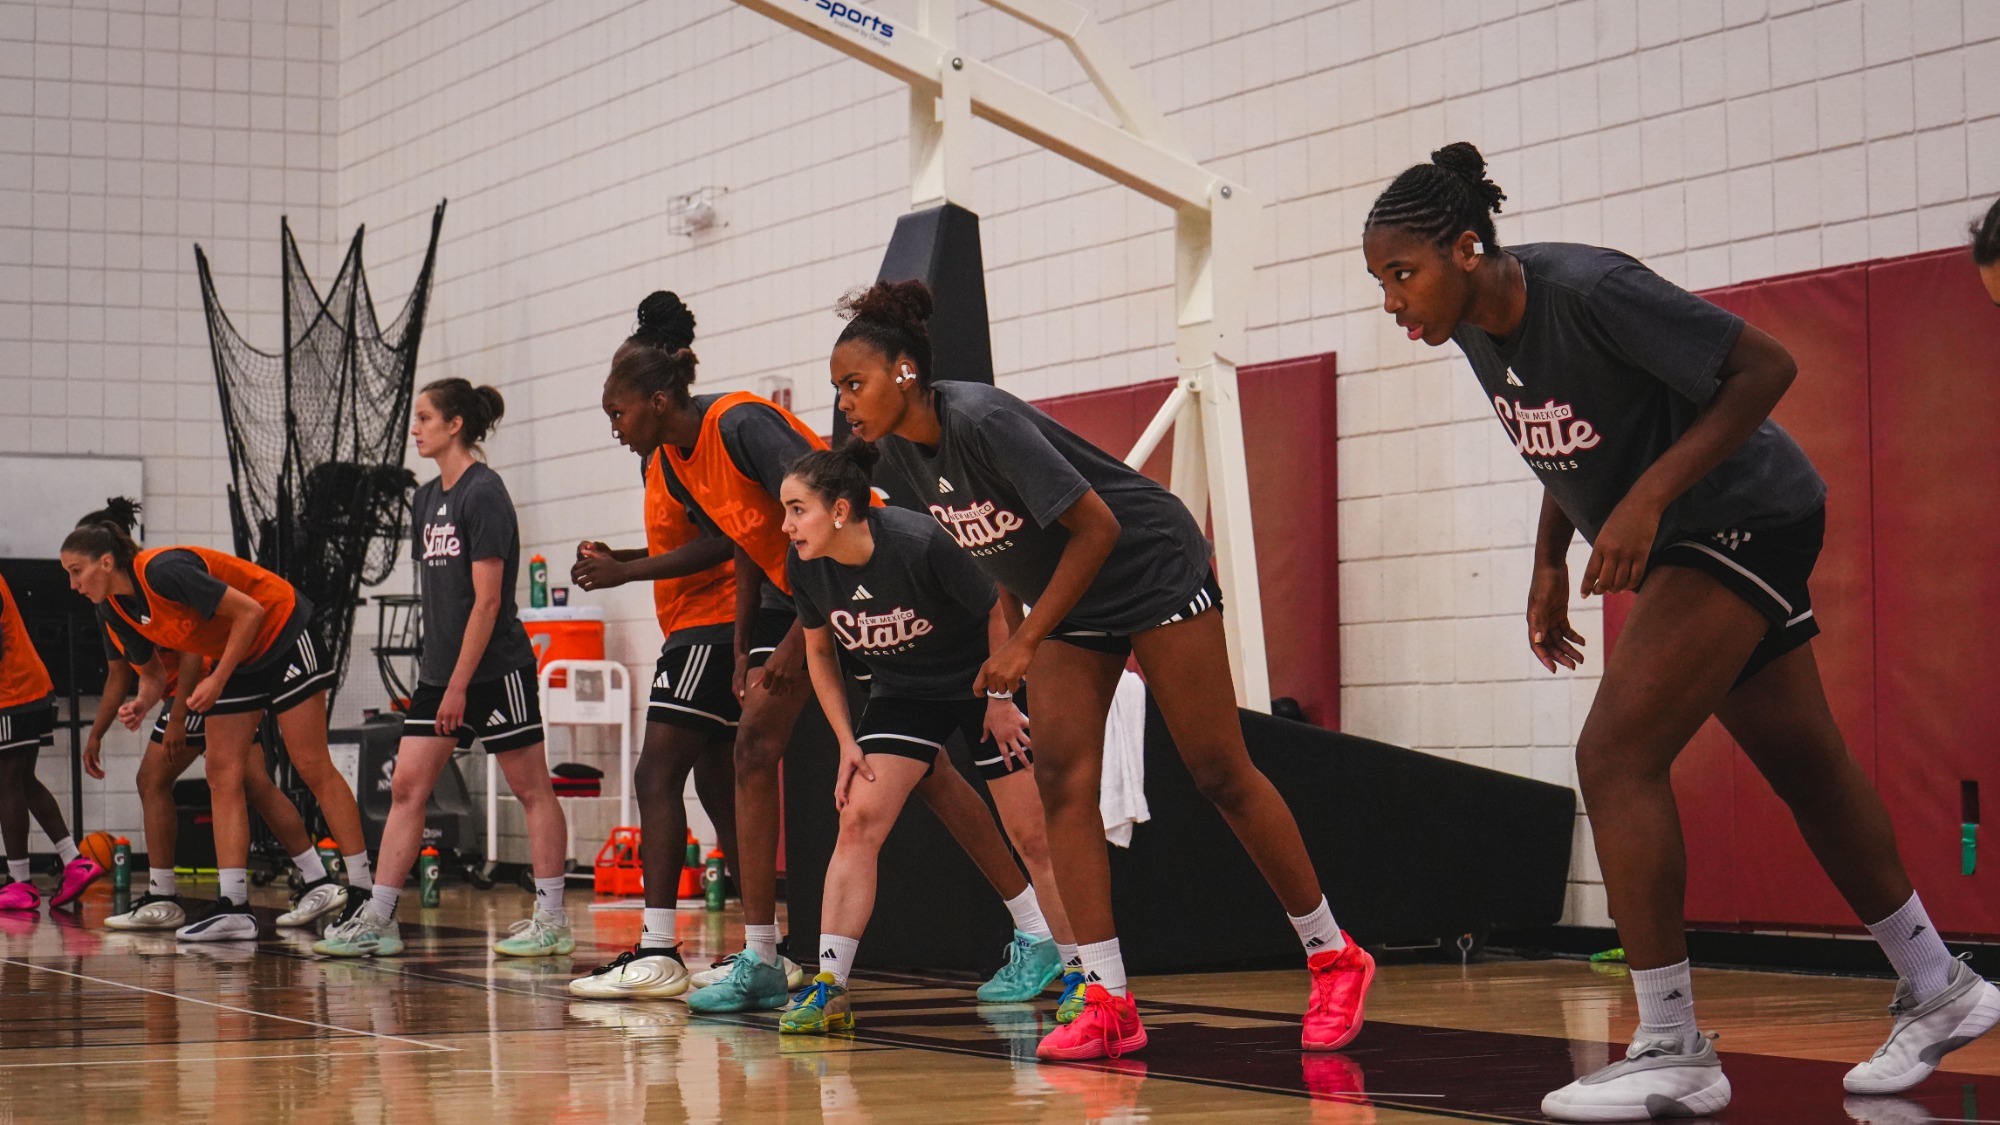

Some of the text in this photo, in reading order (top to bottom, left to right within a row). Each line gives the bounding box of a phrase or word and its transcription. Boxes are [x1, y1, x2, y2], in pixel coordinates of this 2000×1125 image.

[1517, 407, 1569, 420] NEW MEXICO
[1494, 395, 1601, 456] State
[1530, 460, 1578, 471] AGGIES
[949, 504, 992, 521] NEW MEXICO
[929, 502, 1024, 549] State
[423, 523, 461, 559] State
[970, 540, 1014, 557] AGGIES
[859, 612, 913, 626] NEW MEXICO
[830, 607, 934, 650] State
[864, 642, 915, 656] AGGIES
[705, 867, 718, 882] G
